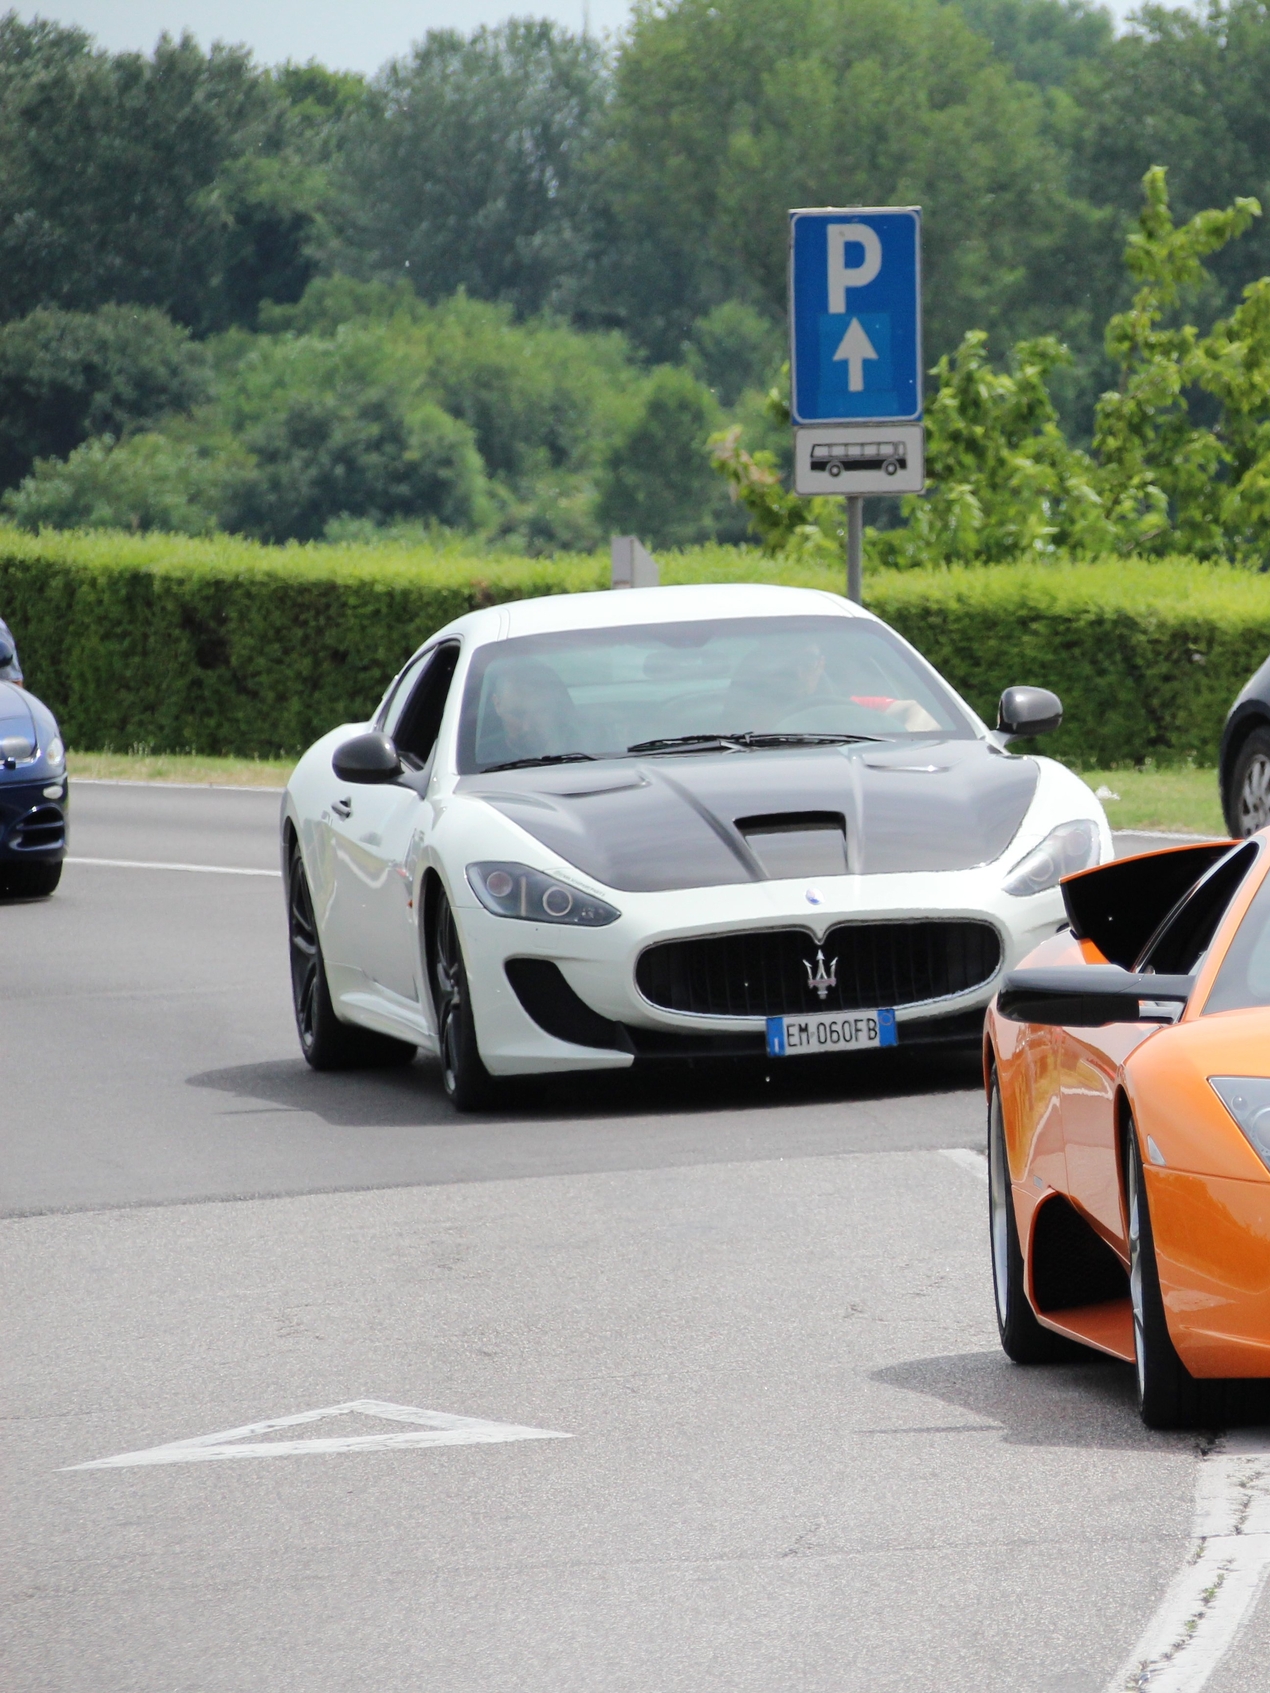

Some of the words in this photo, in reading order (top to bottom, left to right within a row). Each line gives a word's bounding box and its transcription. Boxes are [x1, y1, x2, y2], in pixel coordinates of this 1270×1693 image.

[826, 223, 882, 314] P
[786, 1022, 811, 1047] EM
[816, 1018, 878, 1044] 060FB
